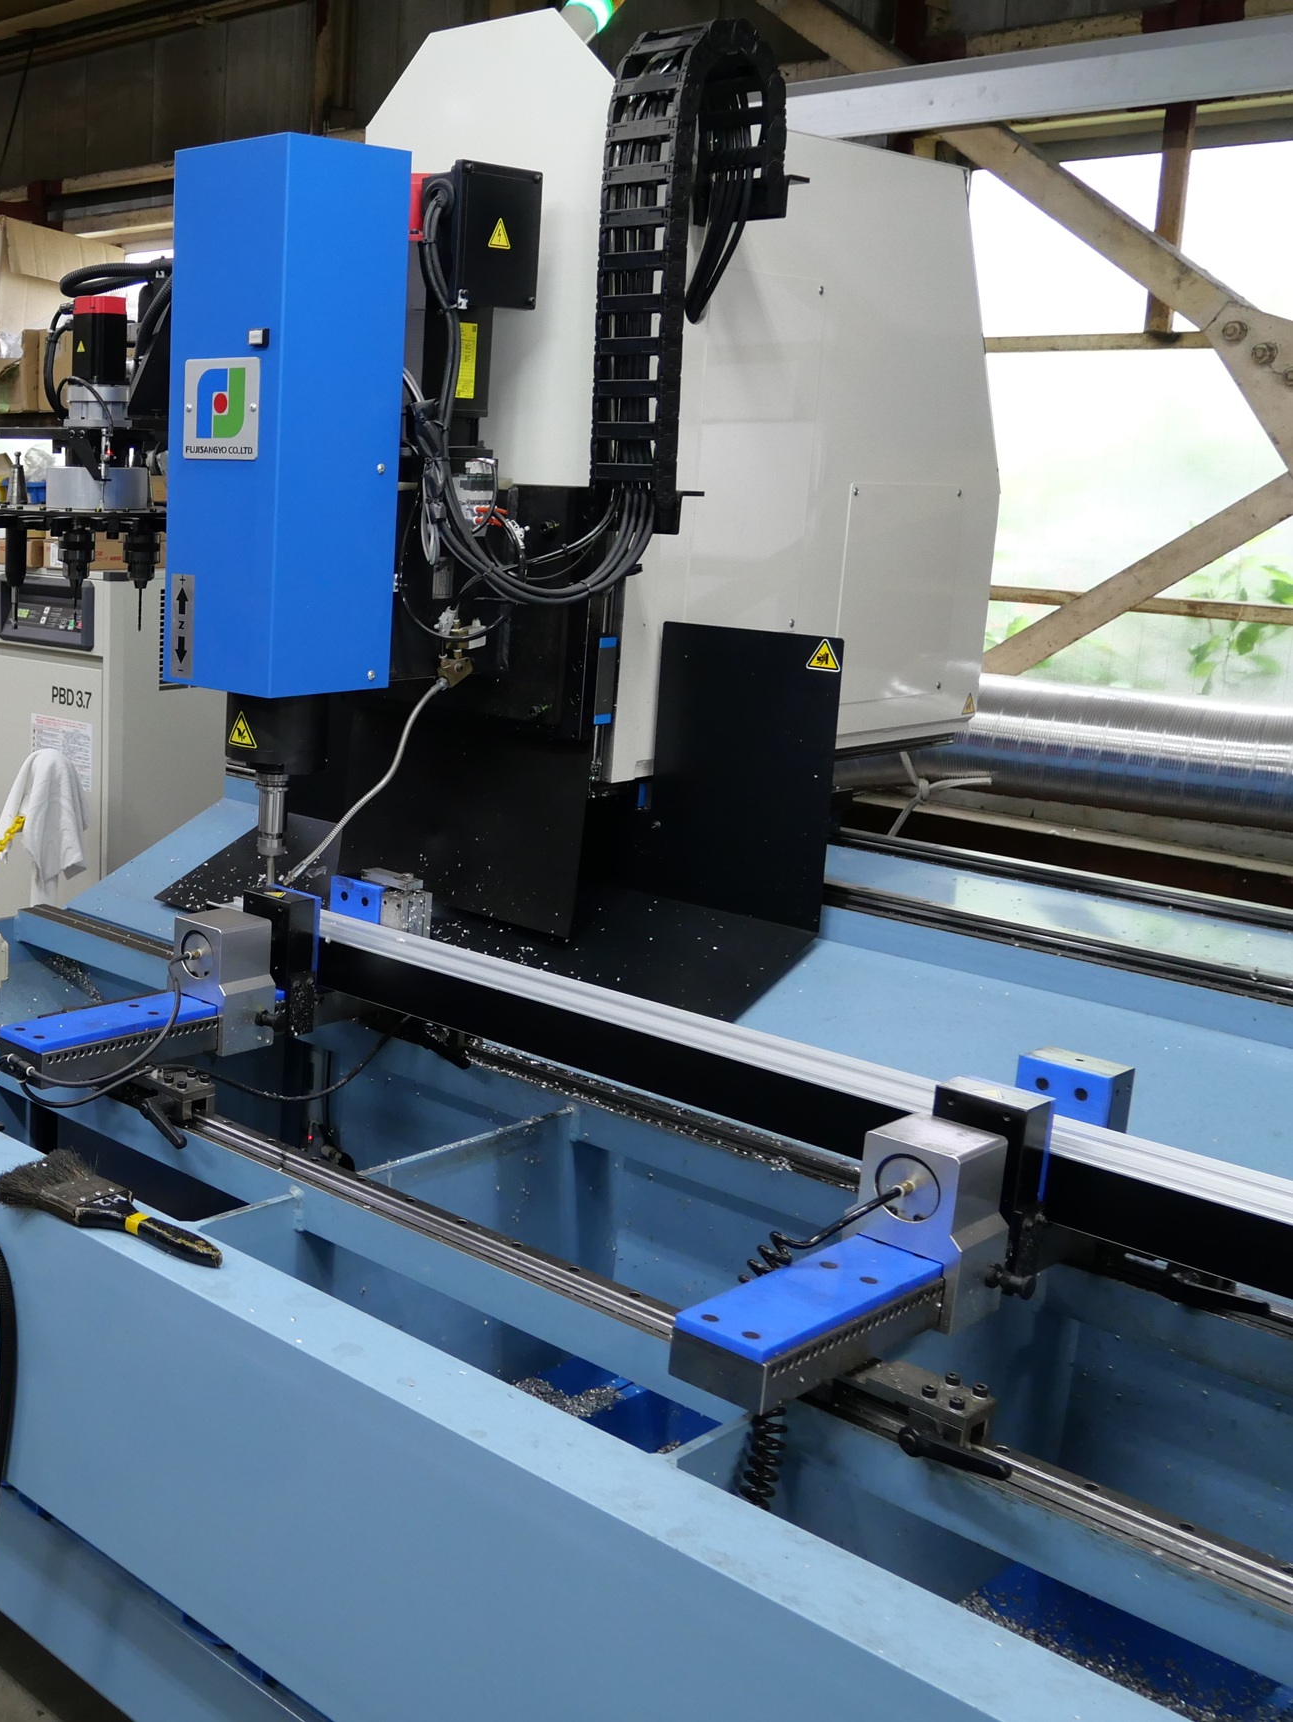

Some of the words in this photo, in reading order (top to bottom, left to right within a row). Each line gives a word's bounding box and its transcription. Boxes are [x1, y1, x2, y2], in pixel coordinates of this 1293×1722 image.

[185, 446, 227, 454] FUJISANGYO
[51, 686, 74, 706] PBD
[76, 690, 92, 709] 3.7
